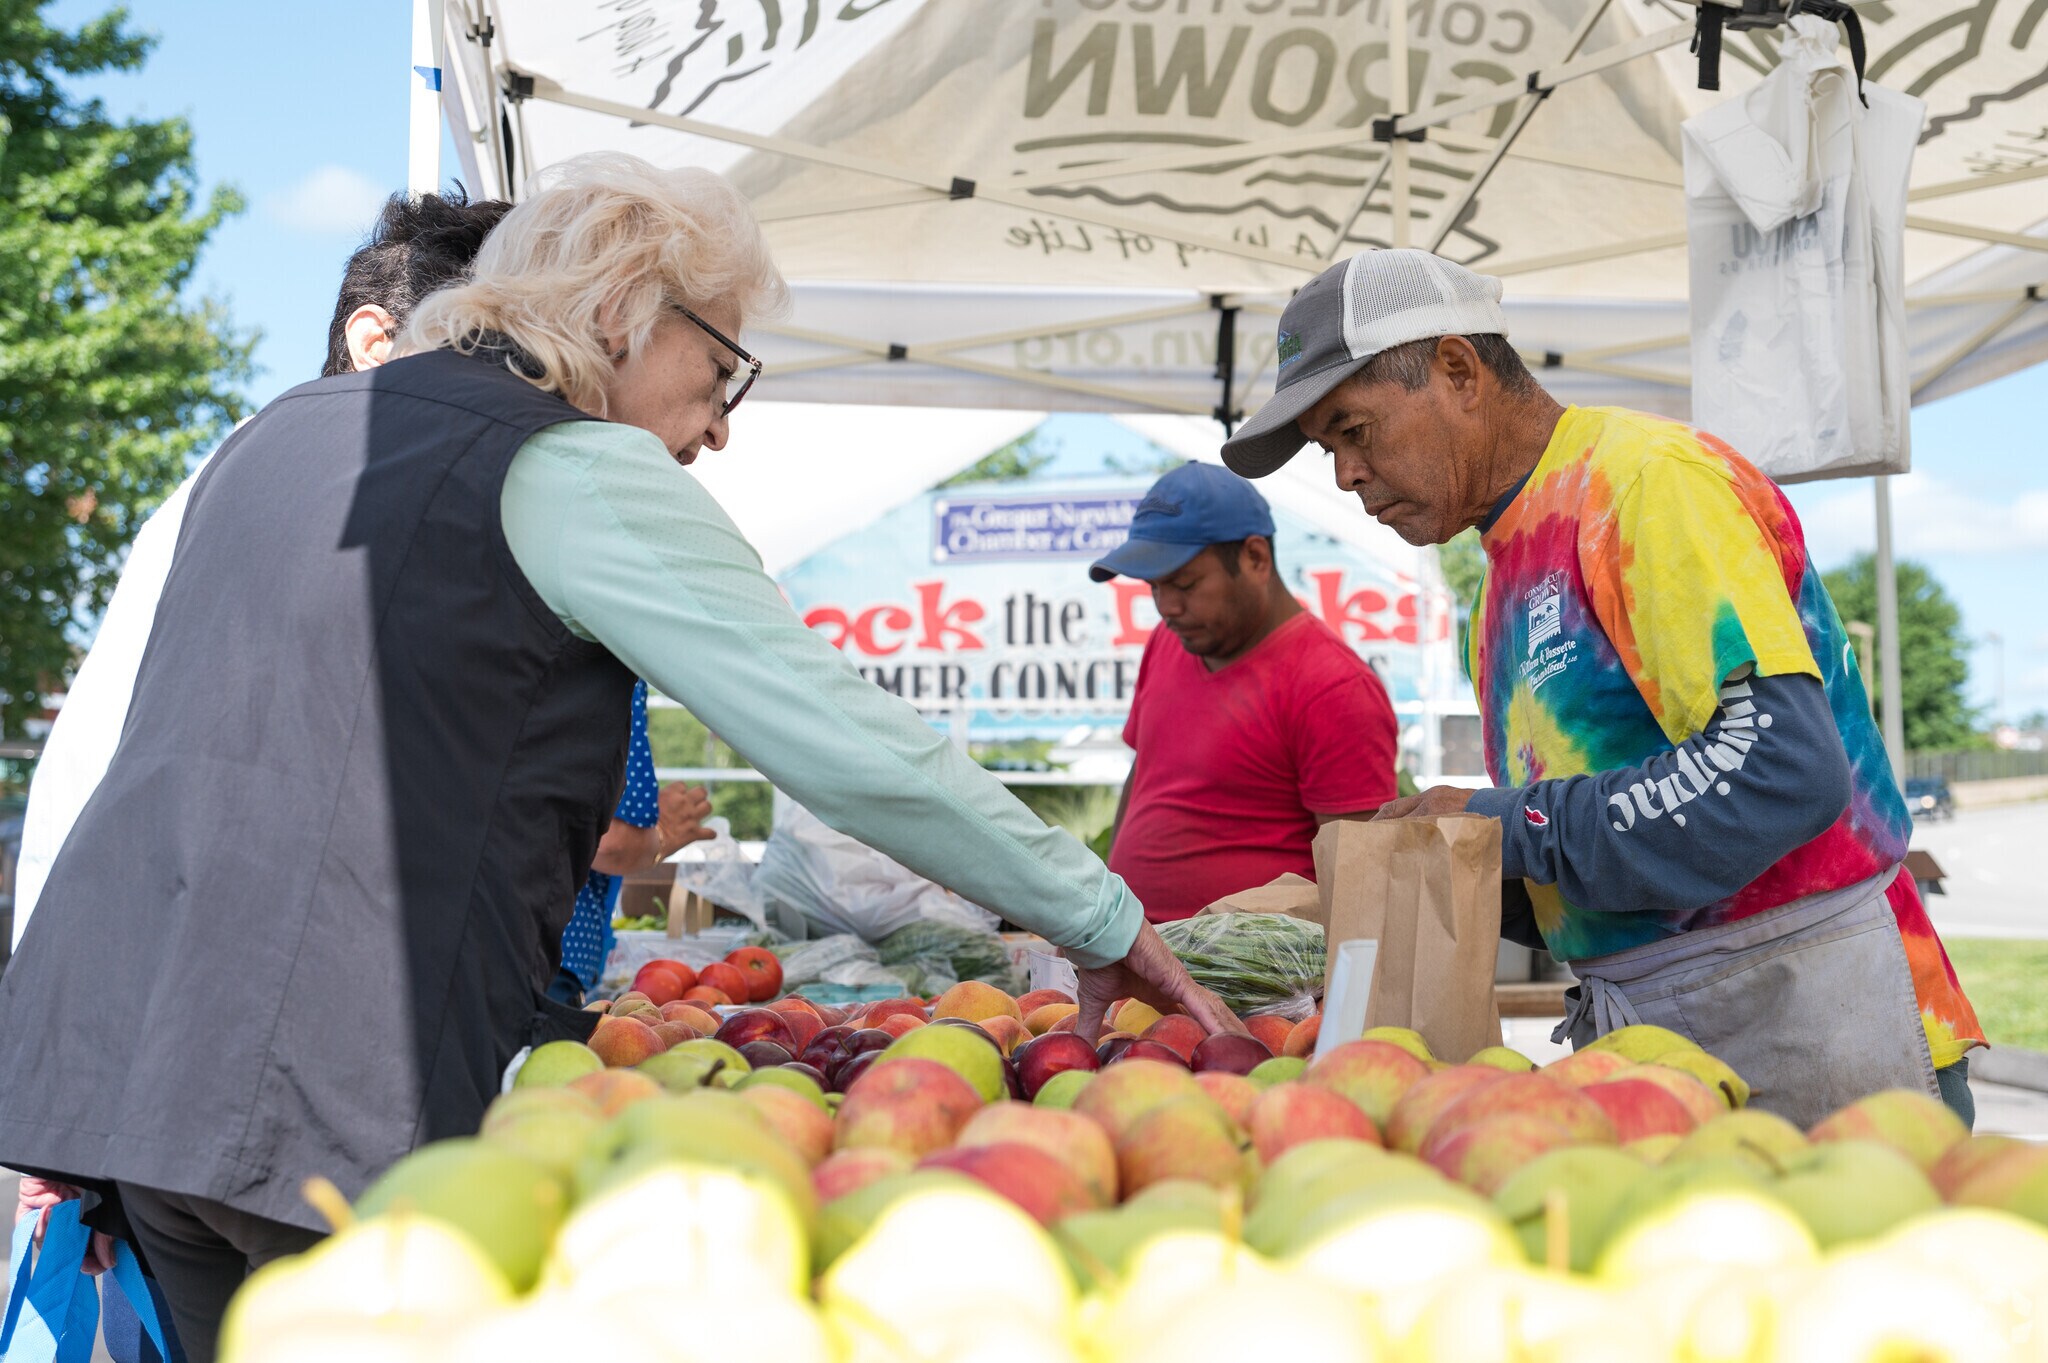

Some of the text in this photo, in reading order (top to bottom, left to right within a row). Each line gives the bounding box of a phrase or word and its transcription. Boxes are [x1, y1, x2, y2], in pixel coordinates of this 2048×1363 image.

[948, 525, 1053, 554] Chamber
[803, 581, 986, 656] ock
[1004, 593, 1086, 646] the
[1528, 582, 1560, 611] GROWN
[988, 659, 1135, 713] CONCE
[1607, 665, 1773, 832] uinnipiac
